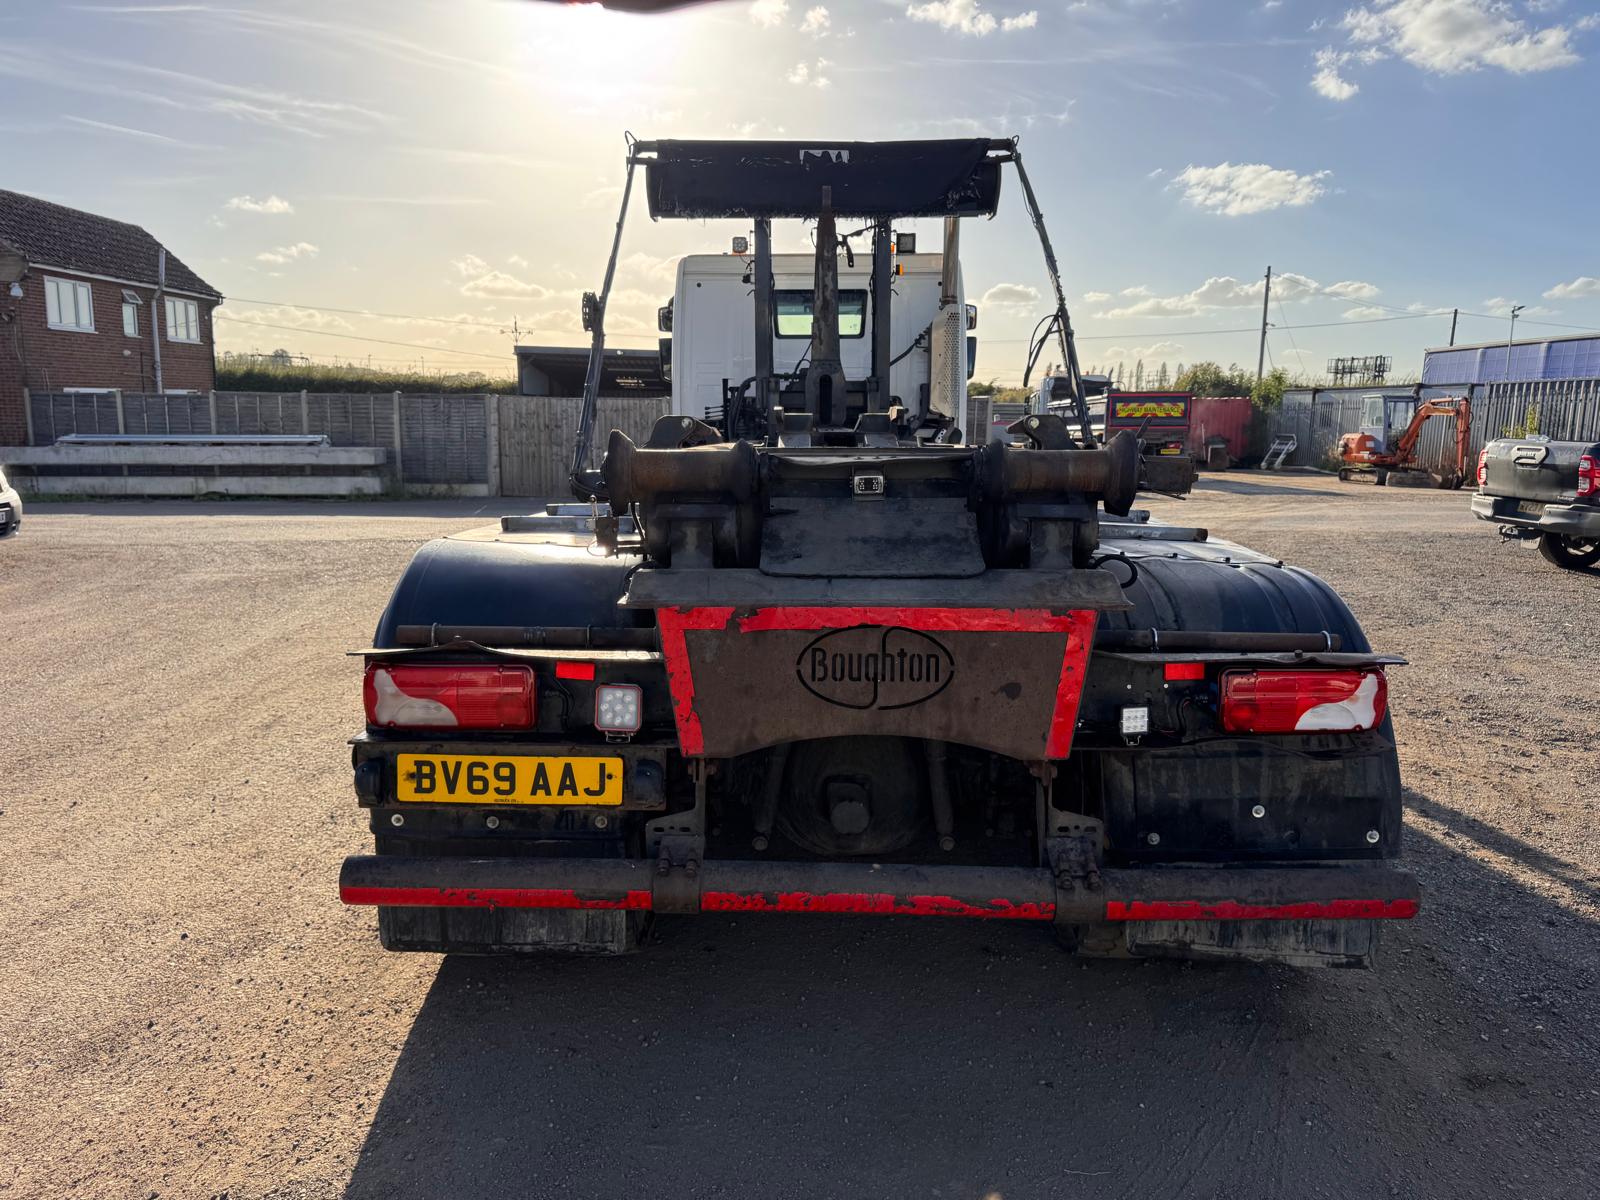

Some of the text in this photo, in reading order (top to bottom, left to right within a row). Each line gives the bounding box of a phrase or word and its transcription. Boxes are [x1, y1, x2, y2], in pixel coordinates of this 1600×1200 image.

[1143, 406, 1180, 414] MAINTENANCE
[811, 638, 940, 695] Boughton
[413, 760, 606, 797] BV69 AAJ
